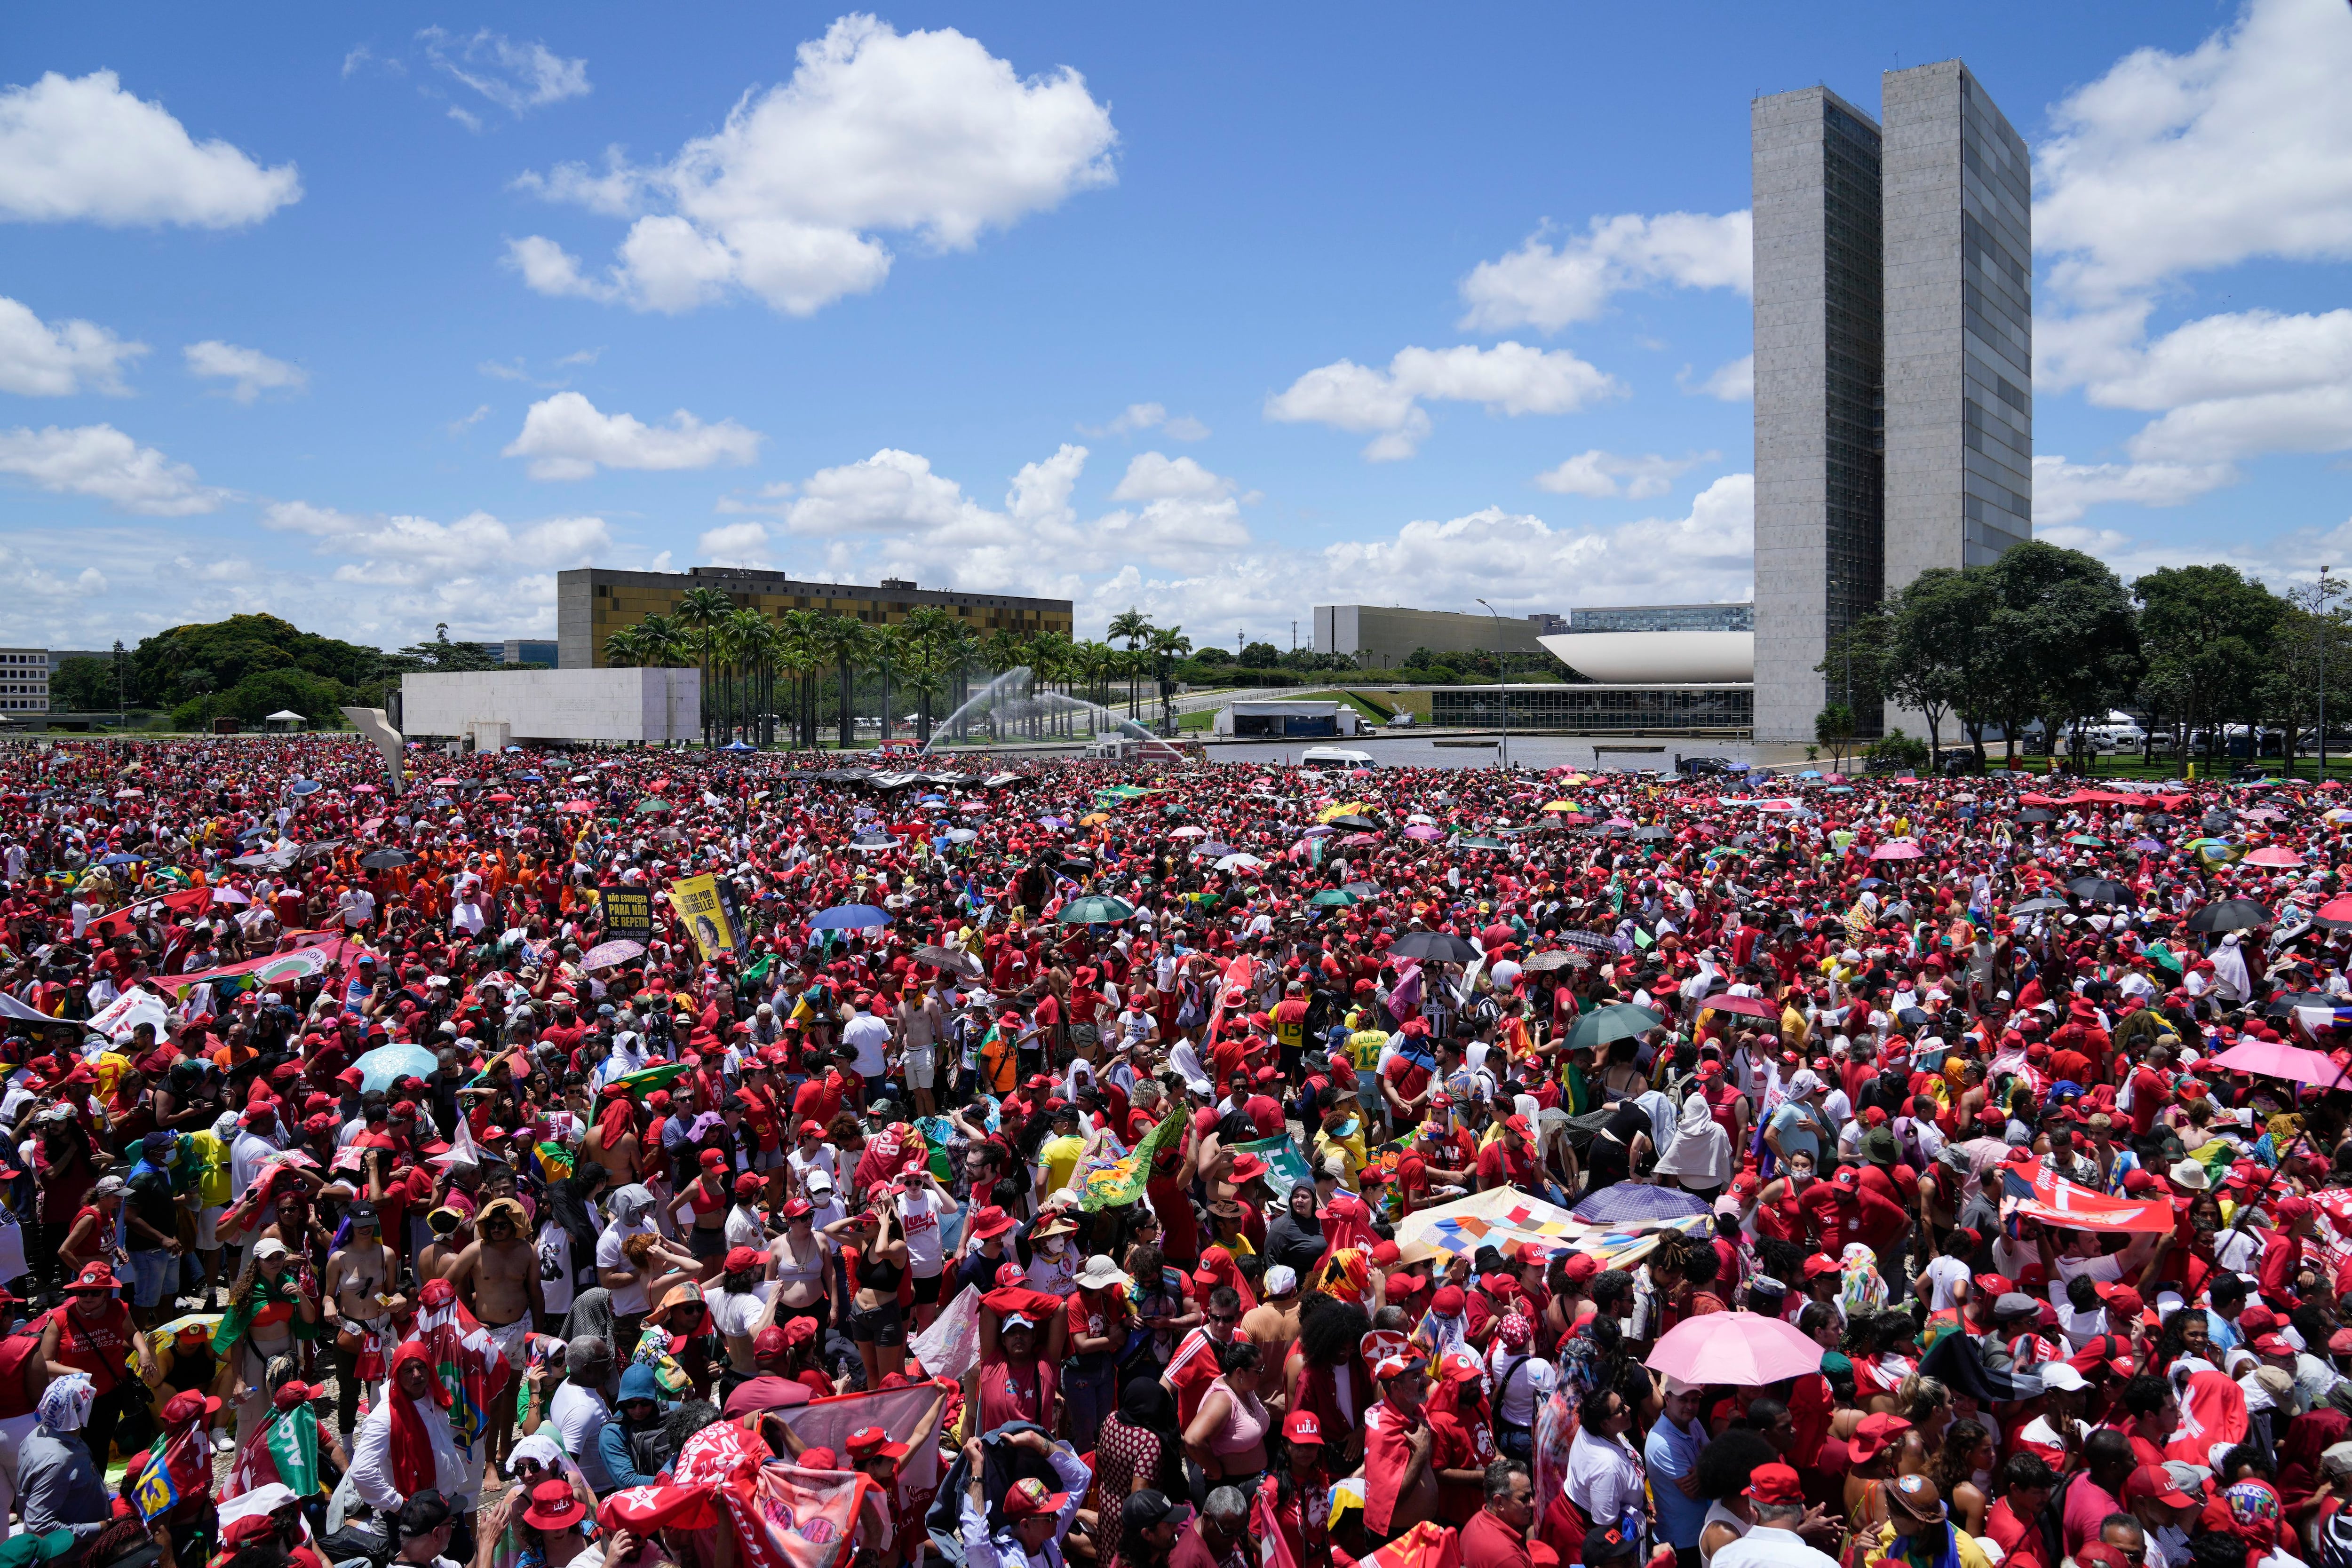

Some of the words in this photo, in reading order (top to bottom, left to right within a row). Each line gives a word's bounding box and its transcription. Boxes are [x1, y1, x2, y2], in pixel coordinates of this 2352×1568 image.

[607, 893, 619, 903] NÃO
[620, 894, 647, 903] ESQUECER
[699, 890, 712, 901] POR
[608, 904, 630, 915] PARA
[632, 902, 647, 915] NÃO
[610, 917, 620, 927] SE
[620, 917, 649, 928] REPETIR
[1359, 1035, 1382, 1044] LULA
[1359, 1045, 1381, 1067] 13
[904, 1212, 937, 1232] LULA
[906, 1227, 926, 1237] PRESIDENTE
[90, 1339, 114, 1349] 022
[1378, 1346, 1398, 1359] 13
[1296, 1423, 1317, 1433] LULA
[632, 1489, 649, 1504] PT
[552, 1500, 570, 1511] LULA
